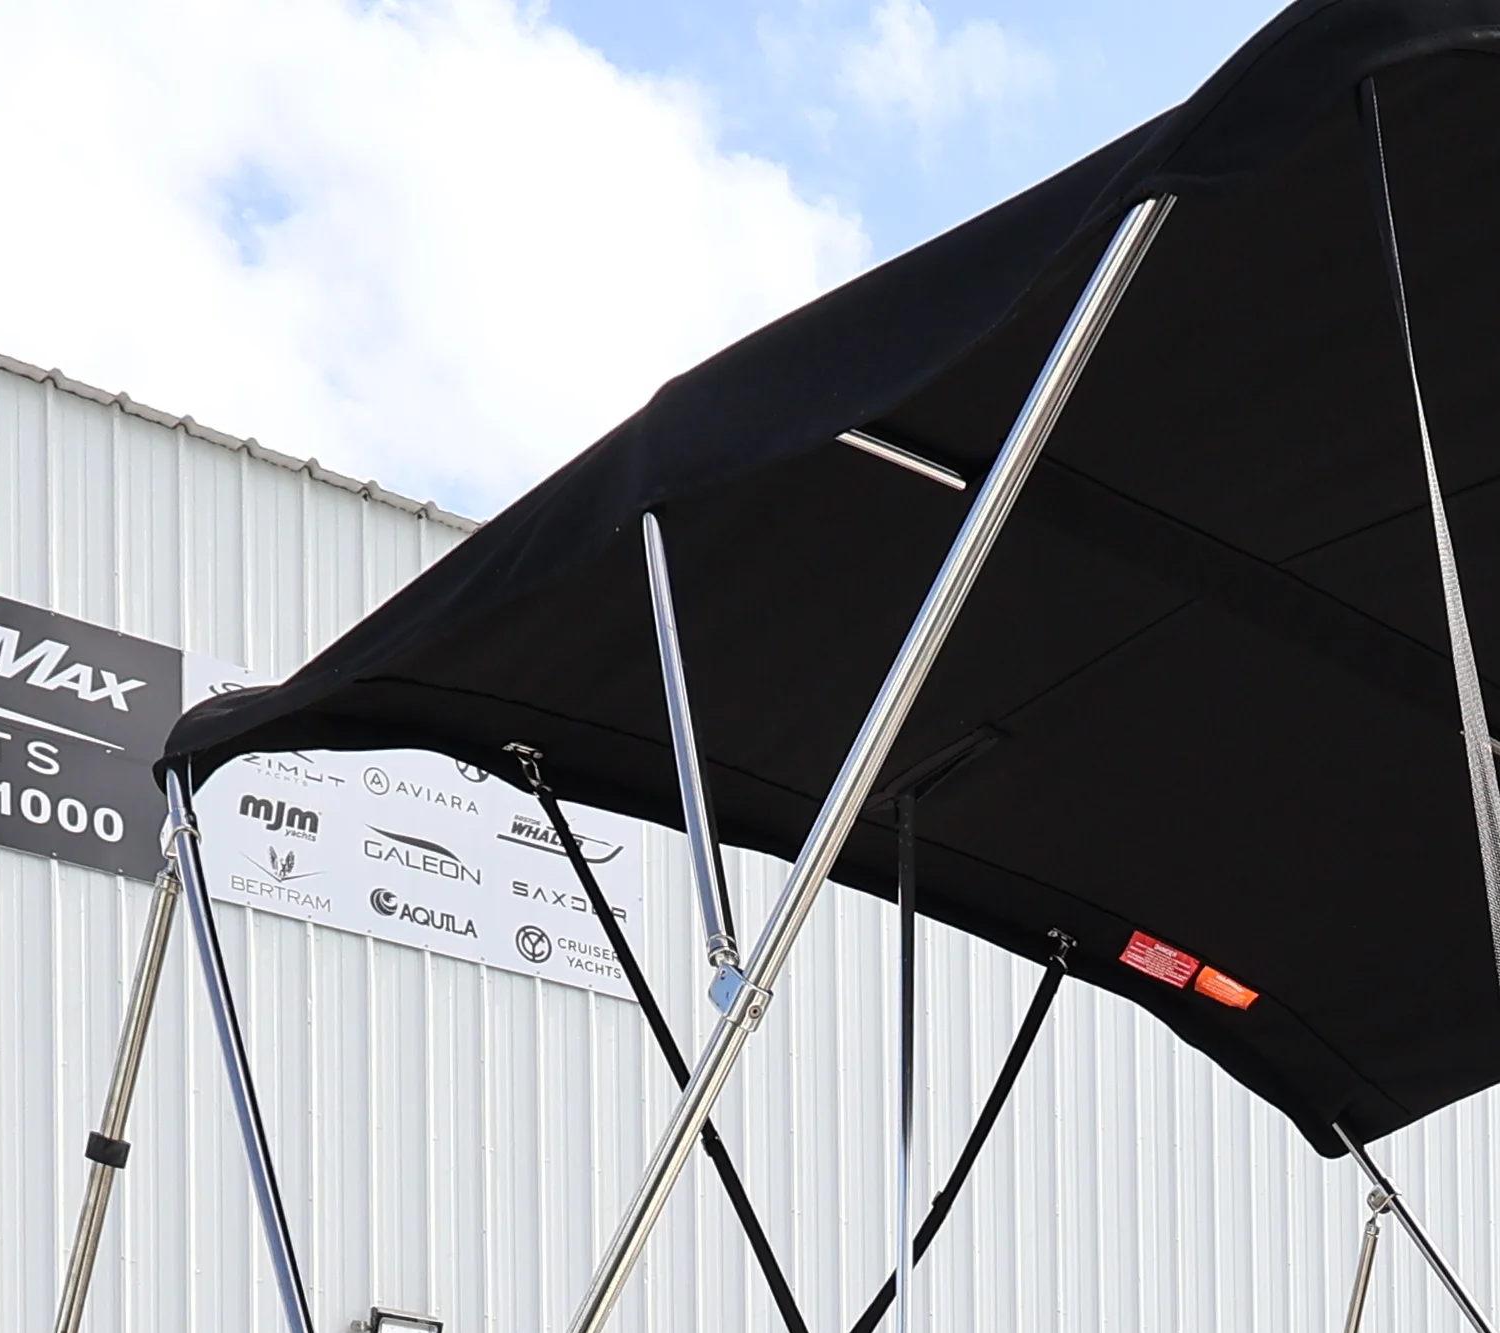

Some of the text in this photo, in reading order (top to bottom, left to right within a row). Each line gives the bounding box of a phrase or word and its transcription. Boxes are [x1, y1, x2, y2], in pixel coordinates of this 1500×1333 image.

[242, 754, 345, 787] ZIMUT
[257, 768, 308, 787] YACHTS
[396, 781, 479, 815] AVIARA
[284, 828, 317, 842] yachts
[511, 821, 584, 850] WHALR
[364, 840, 481, 885] GALEON
[231, 875, 331, 912] BERTRAM
[399, 903, 477, 939] AQUILA
[557, 937, 620, 963] CRUISER
[566, 955, 622, 980] YACHTS
